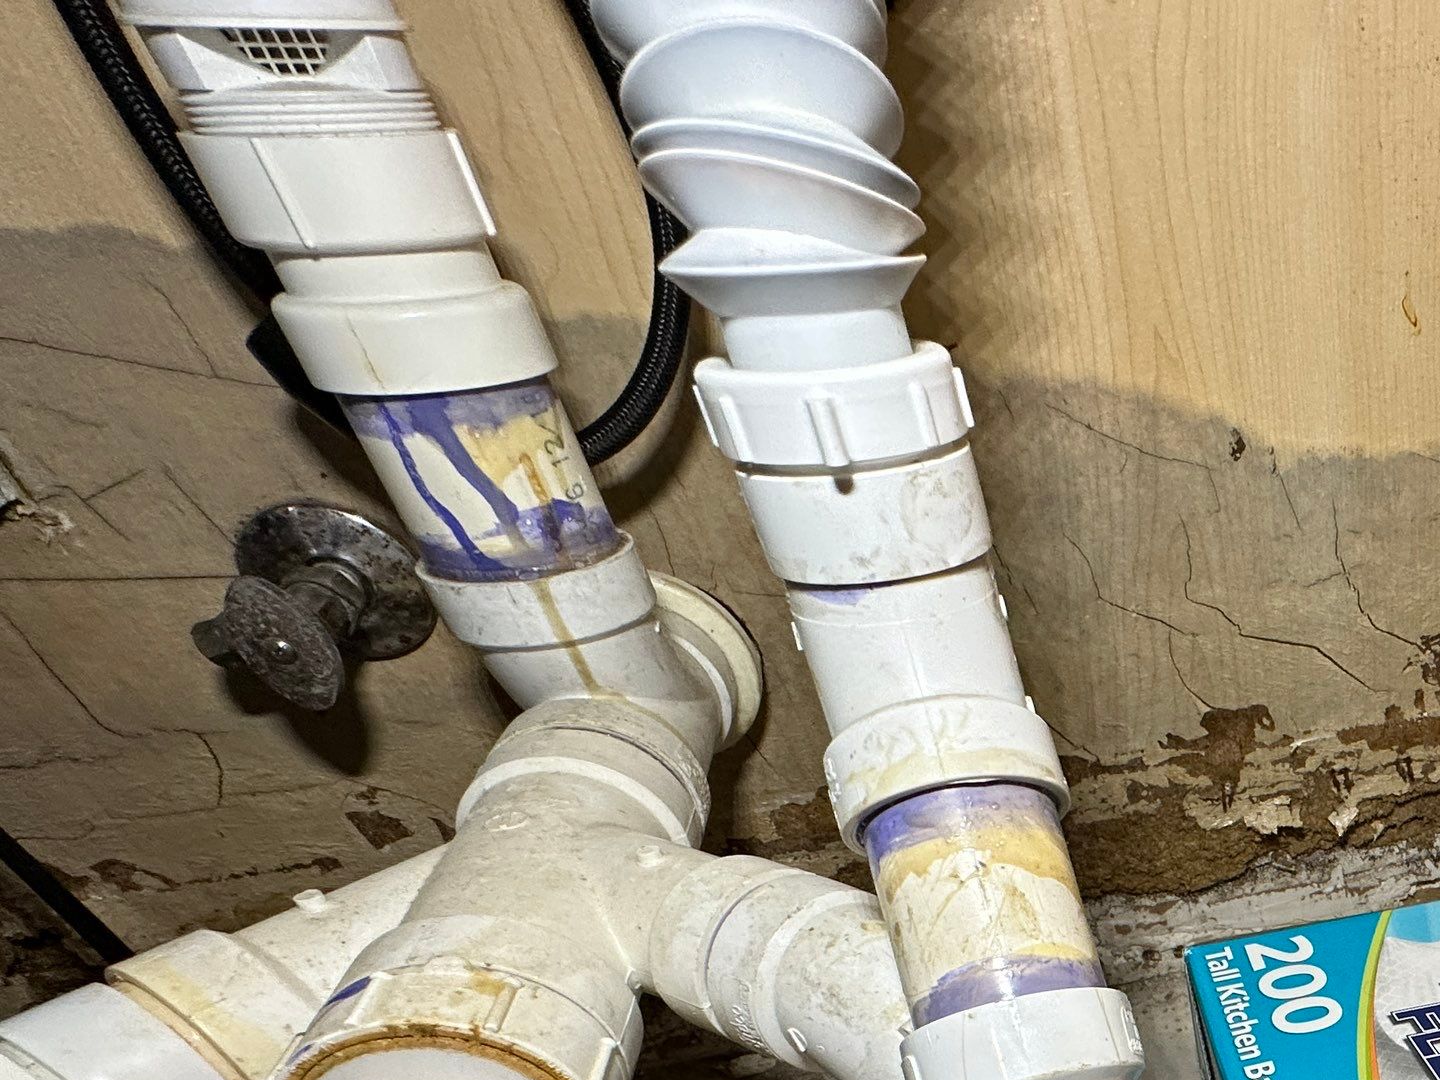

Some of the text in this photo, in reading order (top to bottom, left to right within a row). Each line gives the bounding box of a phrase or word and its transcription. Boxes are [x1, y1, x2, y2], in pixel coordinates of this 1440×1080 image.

[1204, 945, 1241, 982] Tall
[1243, 932, 1342, 1035] 200
[1215, 981, 1264, 1061] Kitchen
